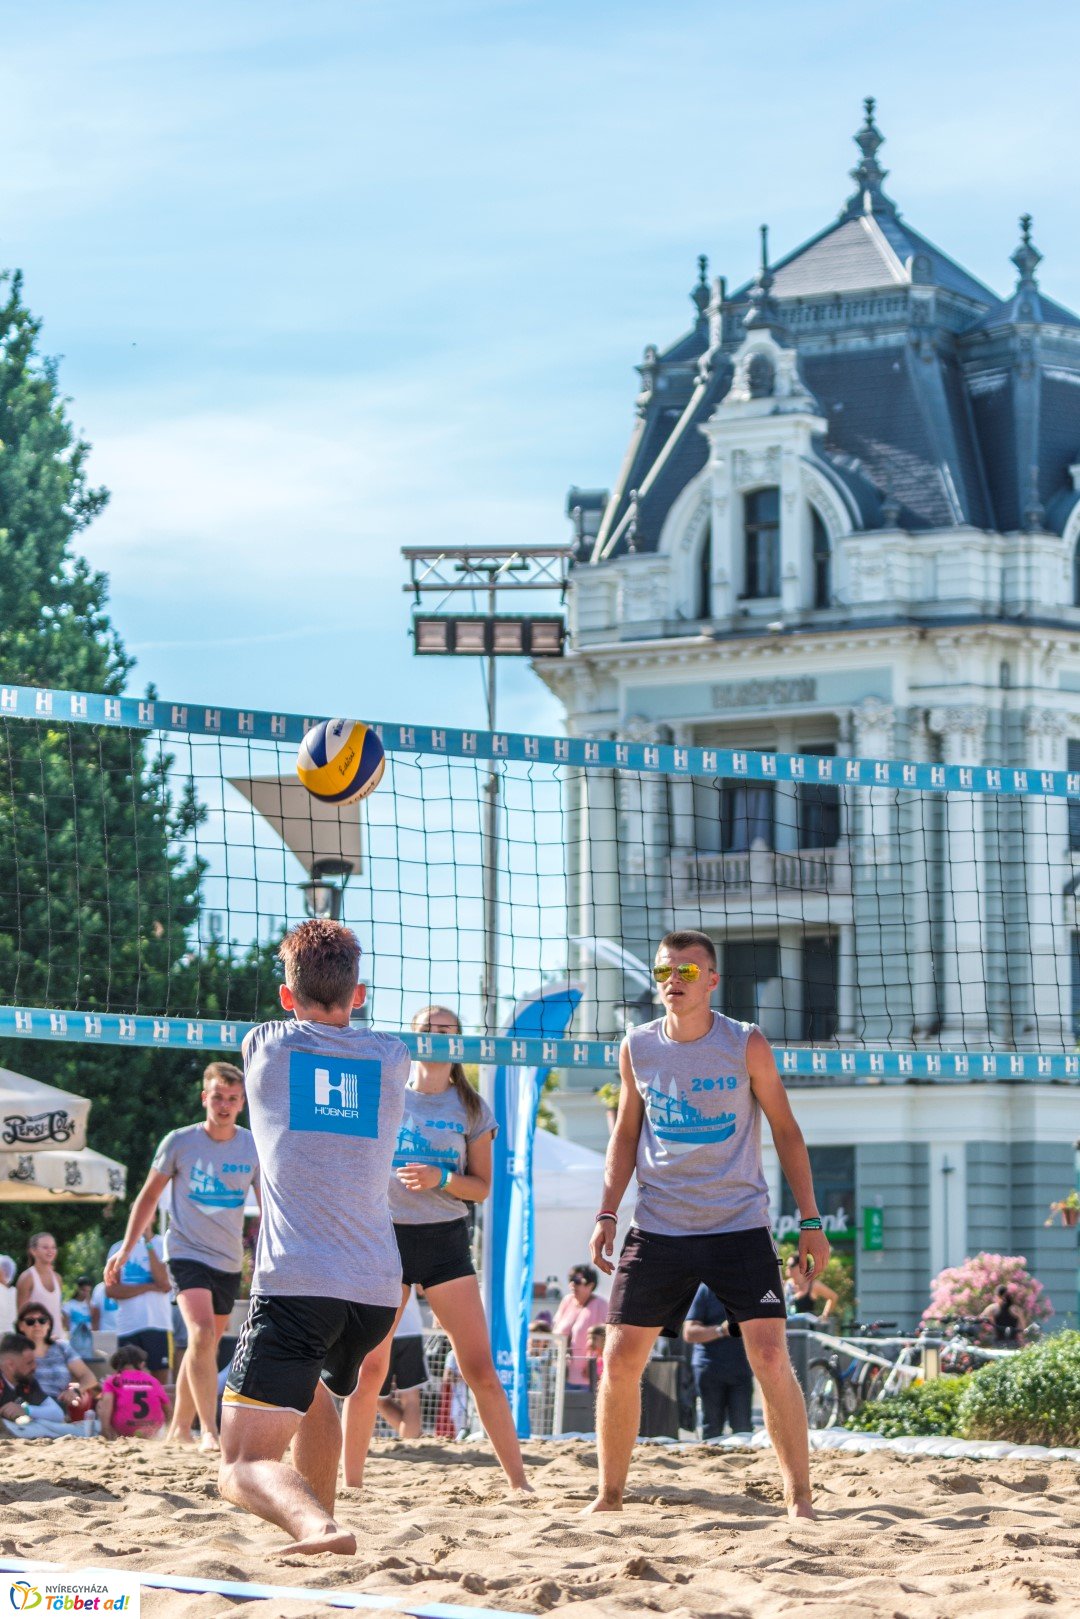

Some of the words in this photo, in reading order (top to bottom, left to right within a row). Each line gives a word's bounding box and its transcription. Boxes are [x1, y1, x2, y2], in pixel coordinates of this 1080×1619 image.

[2, 689, 17, 708] H
[36, 692, 52, 710] H
[71, 696, 87, 714] H
[105, 699, 121, 718] H
[139, 702, 154, 721] H
[172, 706, 187, 724] H
[205, 709, 220, 728] H
[238, 712, 254, 730] H
[271, 716, 286, 734] H
[400, 727, 415, 744] H
[432, 730, 446, 748] H
[462, 733, 476, 750] H
[492, 735, 508, 752] H
[525, 737, 539, 754] H
[555, 740, 569, 758] H
[585, 743, 599, 760] H
[616, 745, 628, 762] H
[644, 748, 659, 764] H
[674, 750, 688, 768] H
[703, 752, 717, 770] H
[733, 753, 747, 771] H
[762, 755, 776, 772] H
[791, 757, 804, 774] H
[819, 760, 832, 777] H
[847, 761, 860, 778] H
[876, 763, 889, 780] H
[903, 765, 917, 782] H
[932, 767, 945, 784] H
[960, 768, 973, 786] H
[987, 770, 1001, 787] H
[1014, 772, 1028, 788] H
[1042, 773, 1054, 790] H
[1067, 774, 1080, 791] H
[15, 1011, 32, 1029] H
[50, 1014, 67, 1032] H
[85, 1016, 102, 1034] H
[119, 1018, 136, 1036] H
[154, 1021, 170, 1038] H
[187, 1023, 203, 1041] H
[220, 1024, 236, 1042] H
[417, 1037, 432, 1054] H
[449, 1038, 464, 1056] H
[480, 1040, 496, 1057] H
[512, 1041, 527, 1058] H
[543, 1042, 558, 1060] H
[574, 1044, 588, 1061] H
[604, 1045, 619, 1062] H
[784, 1052, 797, 1070] H
[812, 1053, 827, 1070] H
[842, 1053, 856, 1070] H
[870, 1054, 884, 1071] H
[898, 1054, 913, 1072] H
[927, 1055, 941, 1072] H
[955, 1056, 968, 1072] H
[983, 1056, 996, 1072] H
[1011, 1056, 1024, 1073] H
[1038, 1056, 1051, 1073] H
[1066, 1056, 1078, 1073] H
[314, 1067, 359, 1110] H
[690, 1076, 737, 1092] 2019
[314, 1106, 359, 1118] HÜBNER
[425, 1120, 464, 1134] 2019
[222, 1163, 252, 1173] 2019
[133, 1391, 149, 1419] 5
